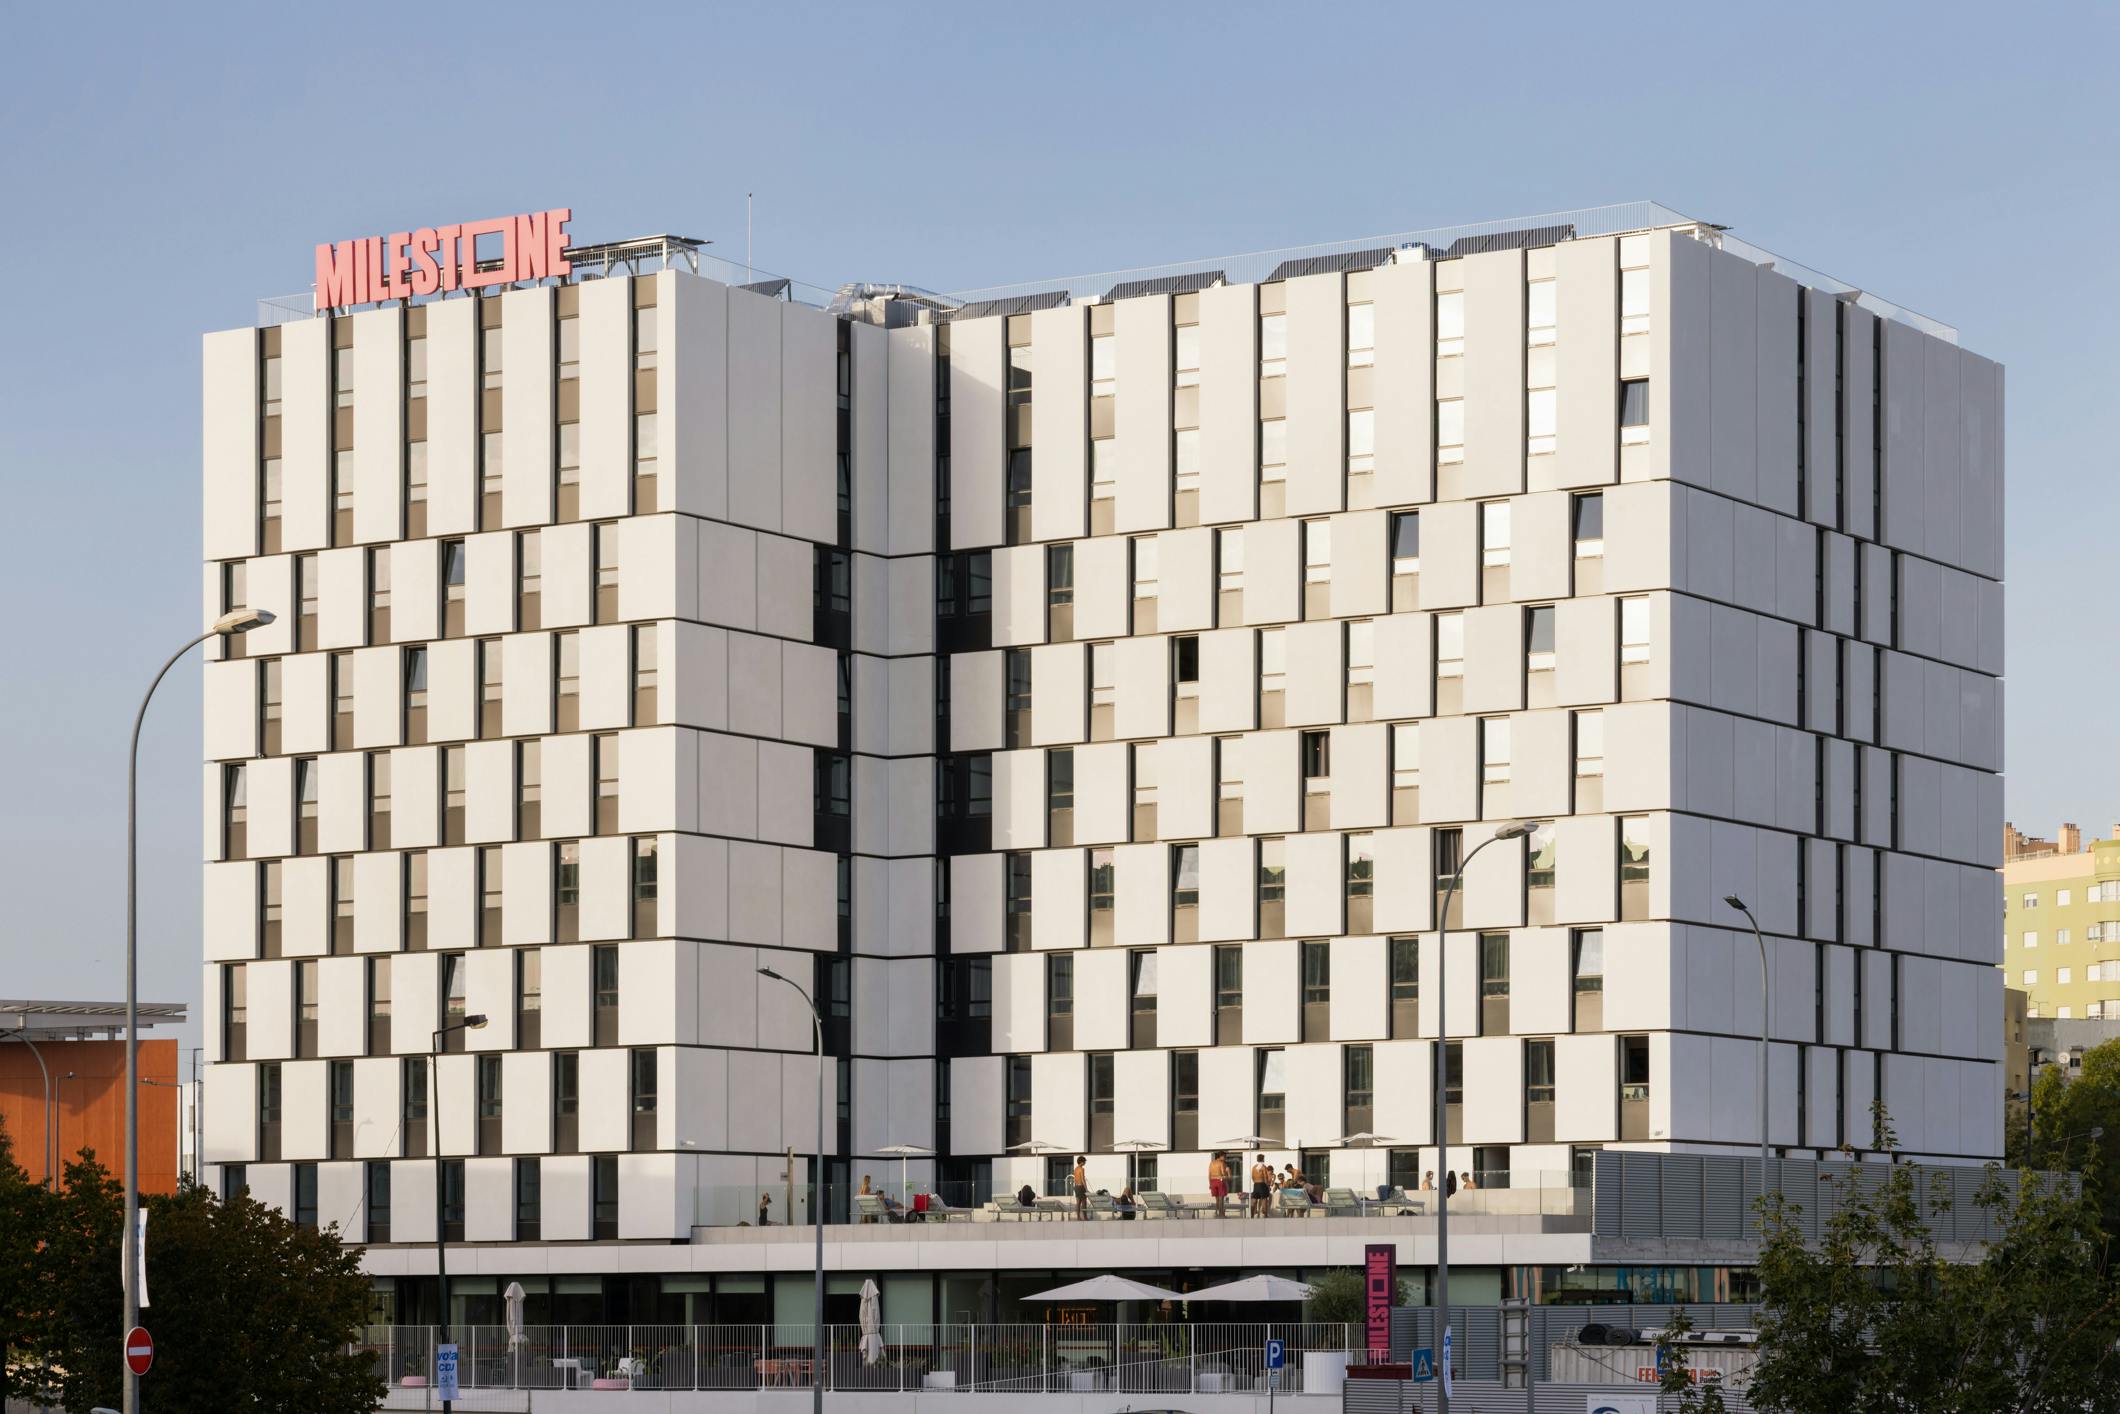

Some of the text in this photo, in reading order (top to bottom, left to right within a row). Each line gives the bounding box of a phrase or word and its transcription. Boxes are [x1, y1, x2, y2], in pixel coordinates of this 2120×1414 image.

[316, 208, 571, 309] MILESTONE
[1270, 1342, 1280, 1366] P
[1368, 1252, 1389, 1360] MILESTONE
